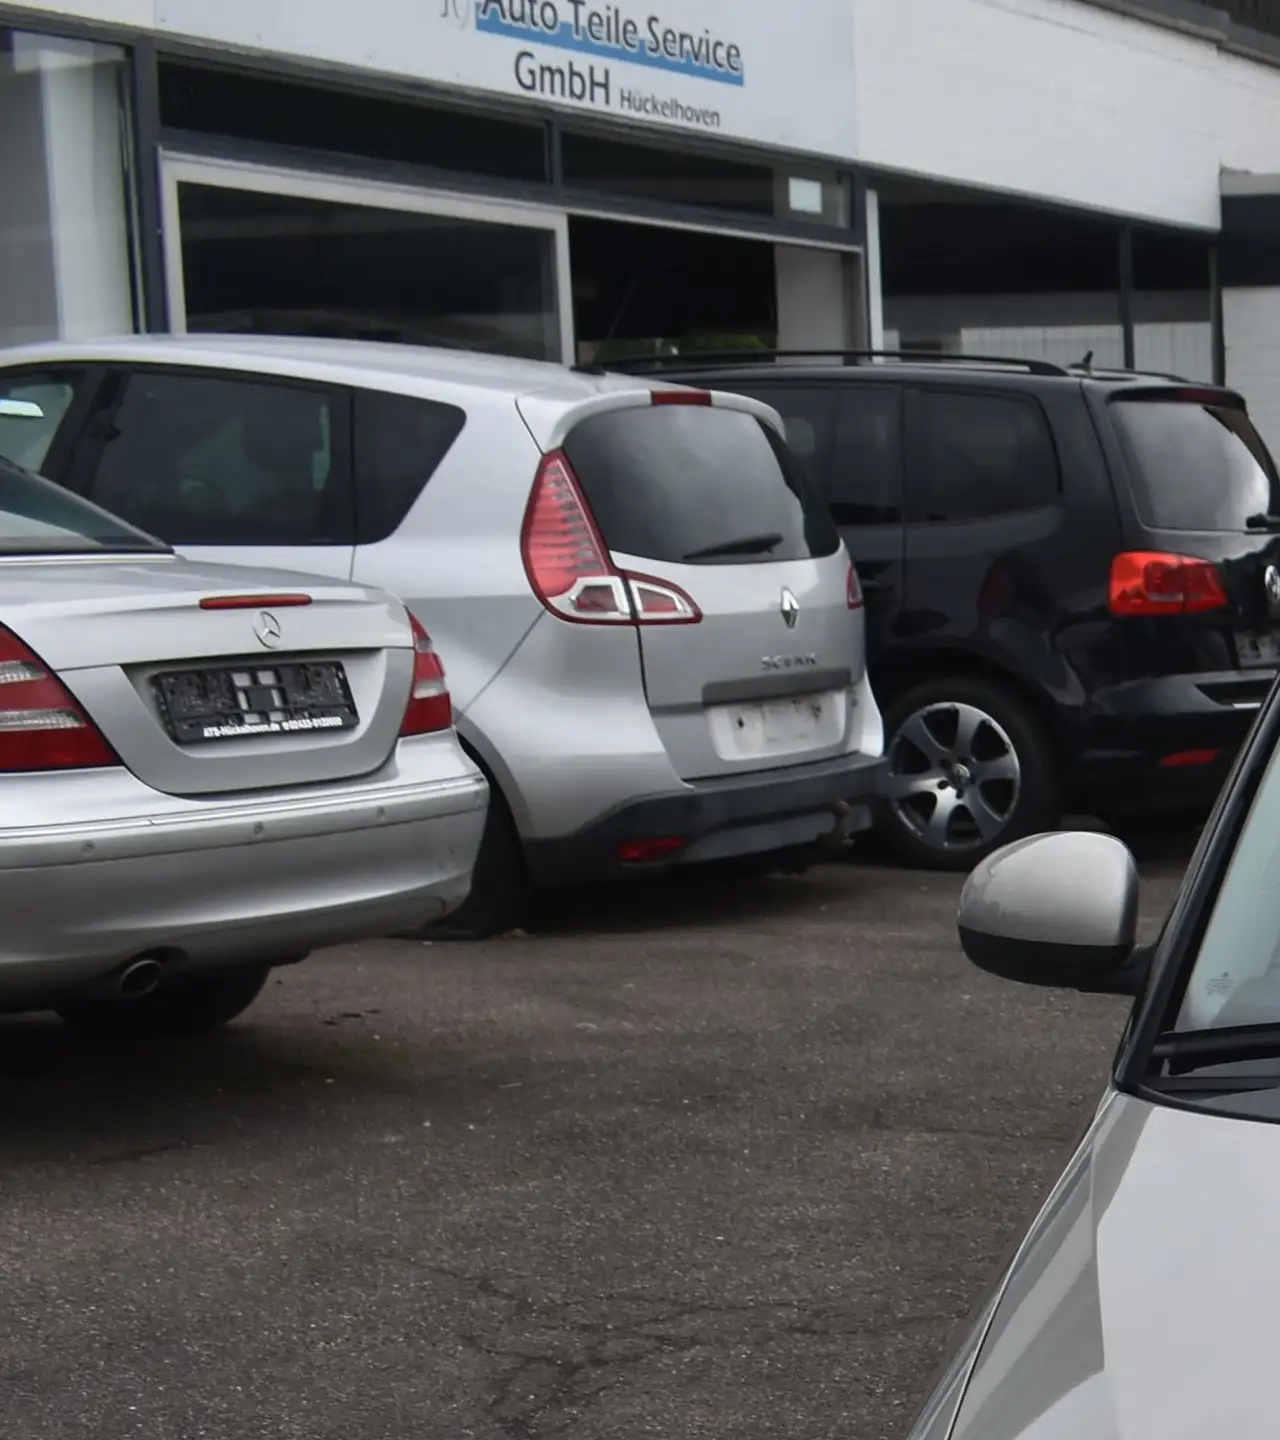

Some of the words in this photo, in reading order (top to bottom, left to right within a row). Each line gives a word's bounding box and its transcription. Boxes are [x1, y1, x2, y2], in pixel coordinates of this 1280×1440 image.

[481, 0, 558, 30] Auto
[566, 0, 638, 49] Teile
[647, 16, 741, 71] Service
[514, 51, 610, 105] GmbH
[619, 88, 721, 127] Hückelhoven
